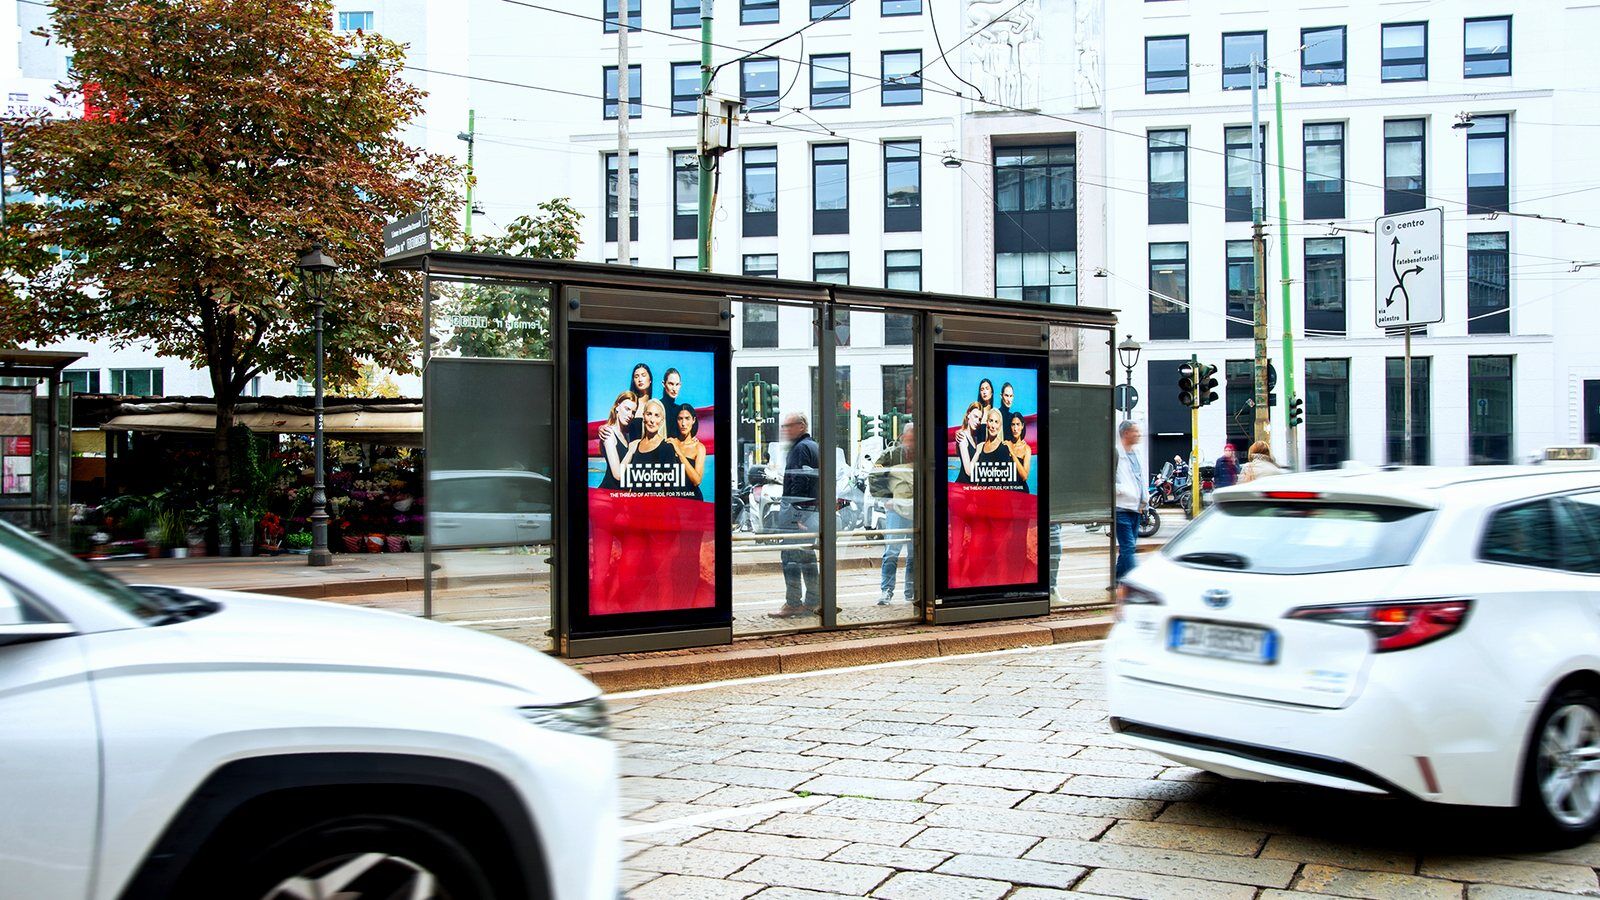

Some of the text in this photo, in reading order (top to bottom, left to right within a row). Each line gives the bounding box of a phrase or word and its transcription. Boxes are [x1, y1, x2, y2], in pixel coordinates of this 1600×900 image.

[1397, 220, 1425, 230] centro
[1396, 254, 1440, 266] fatebenefratelli
[1378, 315, 1400, 323] palestro
[631, 469, 675, 482] Wolford
[978, 466, 1010, 478] Wolford
